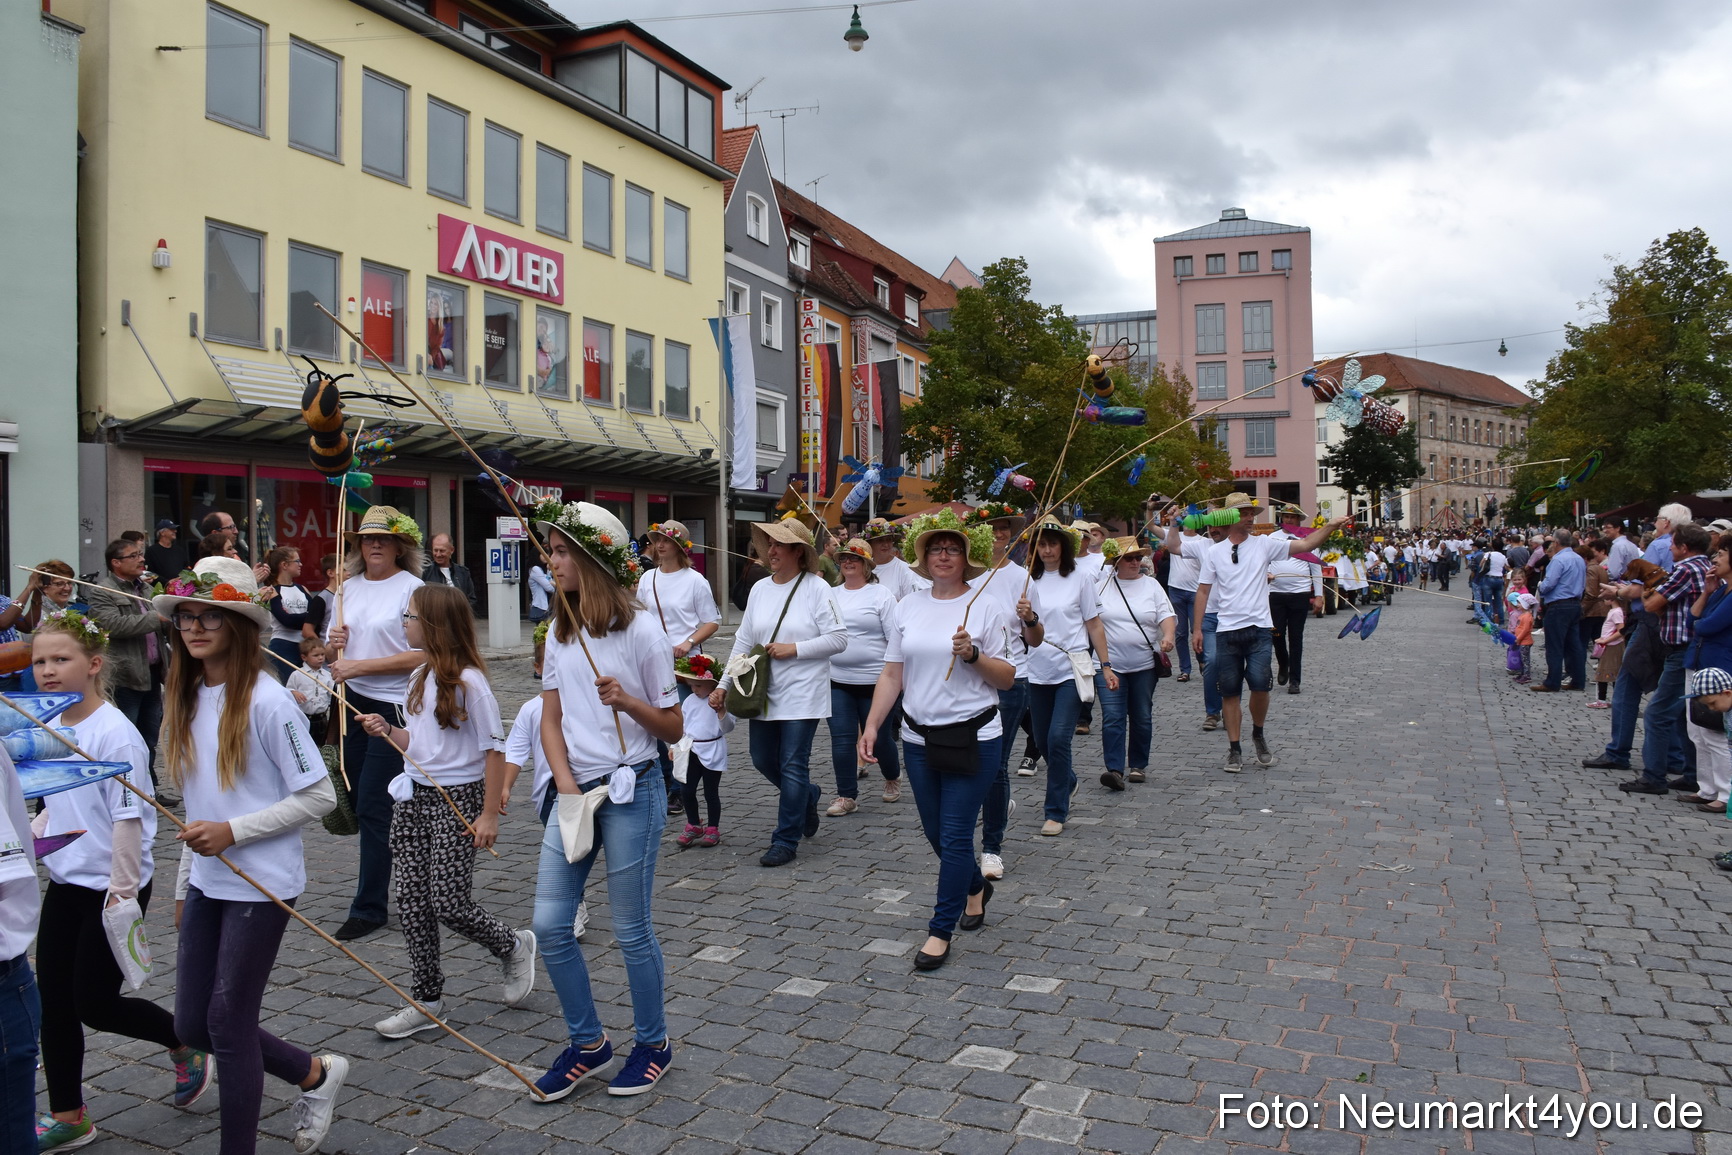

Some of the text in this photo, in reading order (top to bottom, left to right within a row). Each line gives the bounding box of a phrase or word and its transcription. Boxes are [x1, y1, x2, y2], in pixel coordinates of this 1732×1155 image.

[452, 223, 560, 297] ADLER
[515, 480, 563, 506] ADLER
[282, 507, 340, 538] SAL
[492, 552, 500, 563] P
